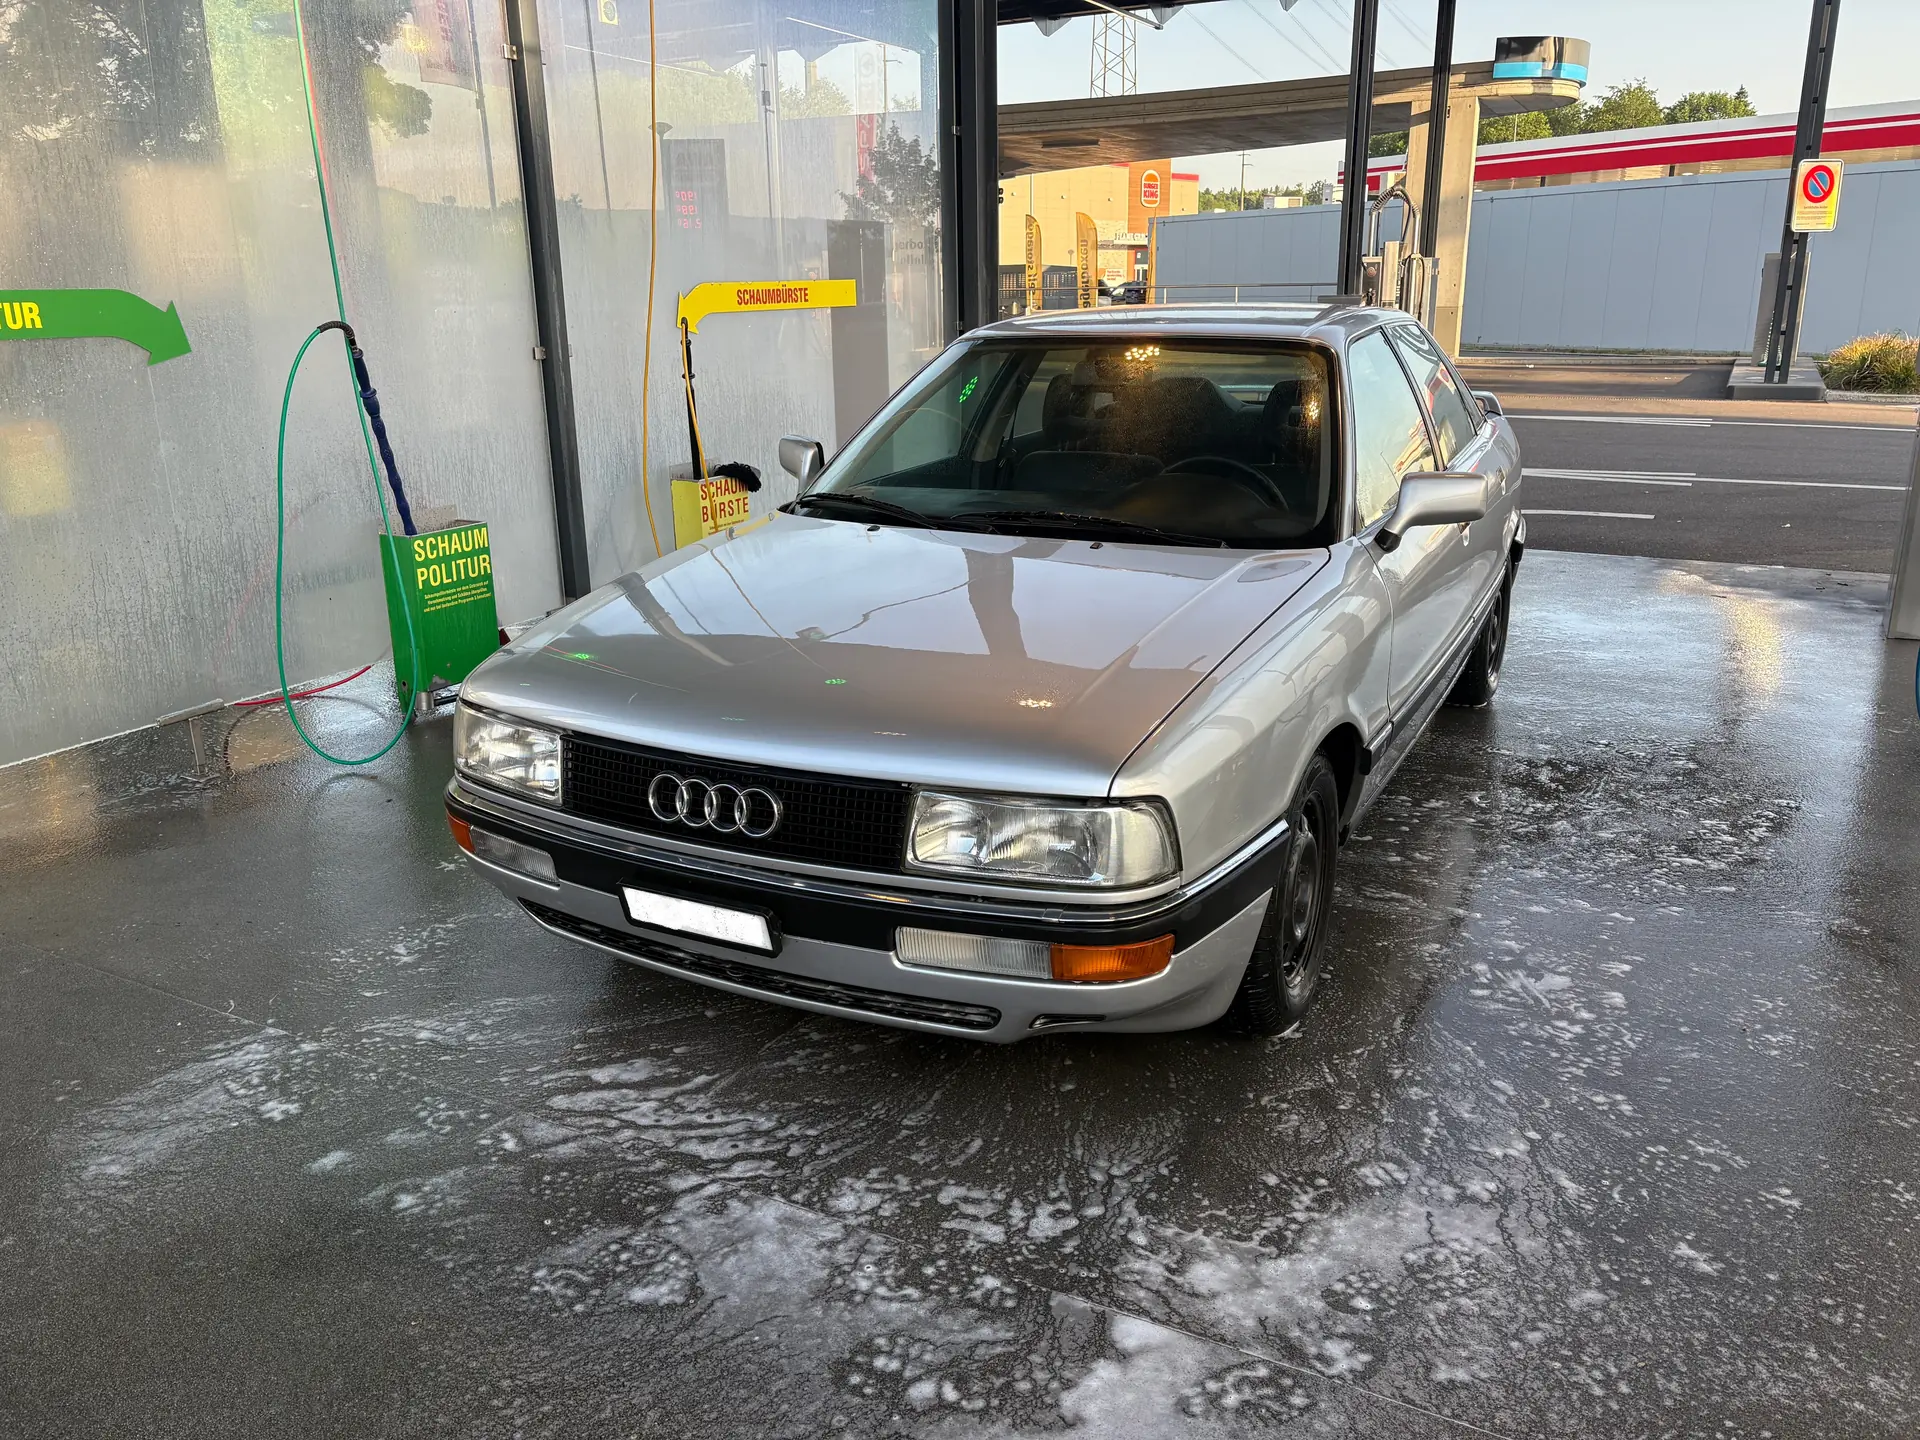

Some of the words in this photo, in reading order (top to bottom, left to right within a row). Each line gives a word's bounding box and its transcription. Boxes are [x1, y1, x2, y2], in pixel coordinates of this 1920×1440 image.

[1143, 182, 1159, 190] BURGER
[1143, 190, 1159, 199] KING
[736, 284, 809, 306] SCHAUMBÜRSTE
[413, 527, 489, 562] SCHAUM
[416, 554, 492, 590] POLITUR
